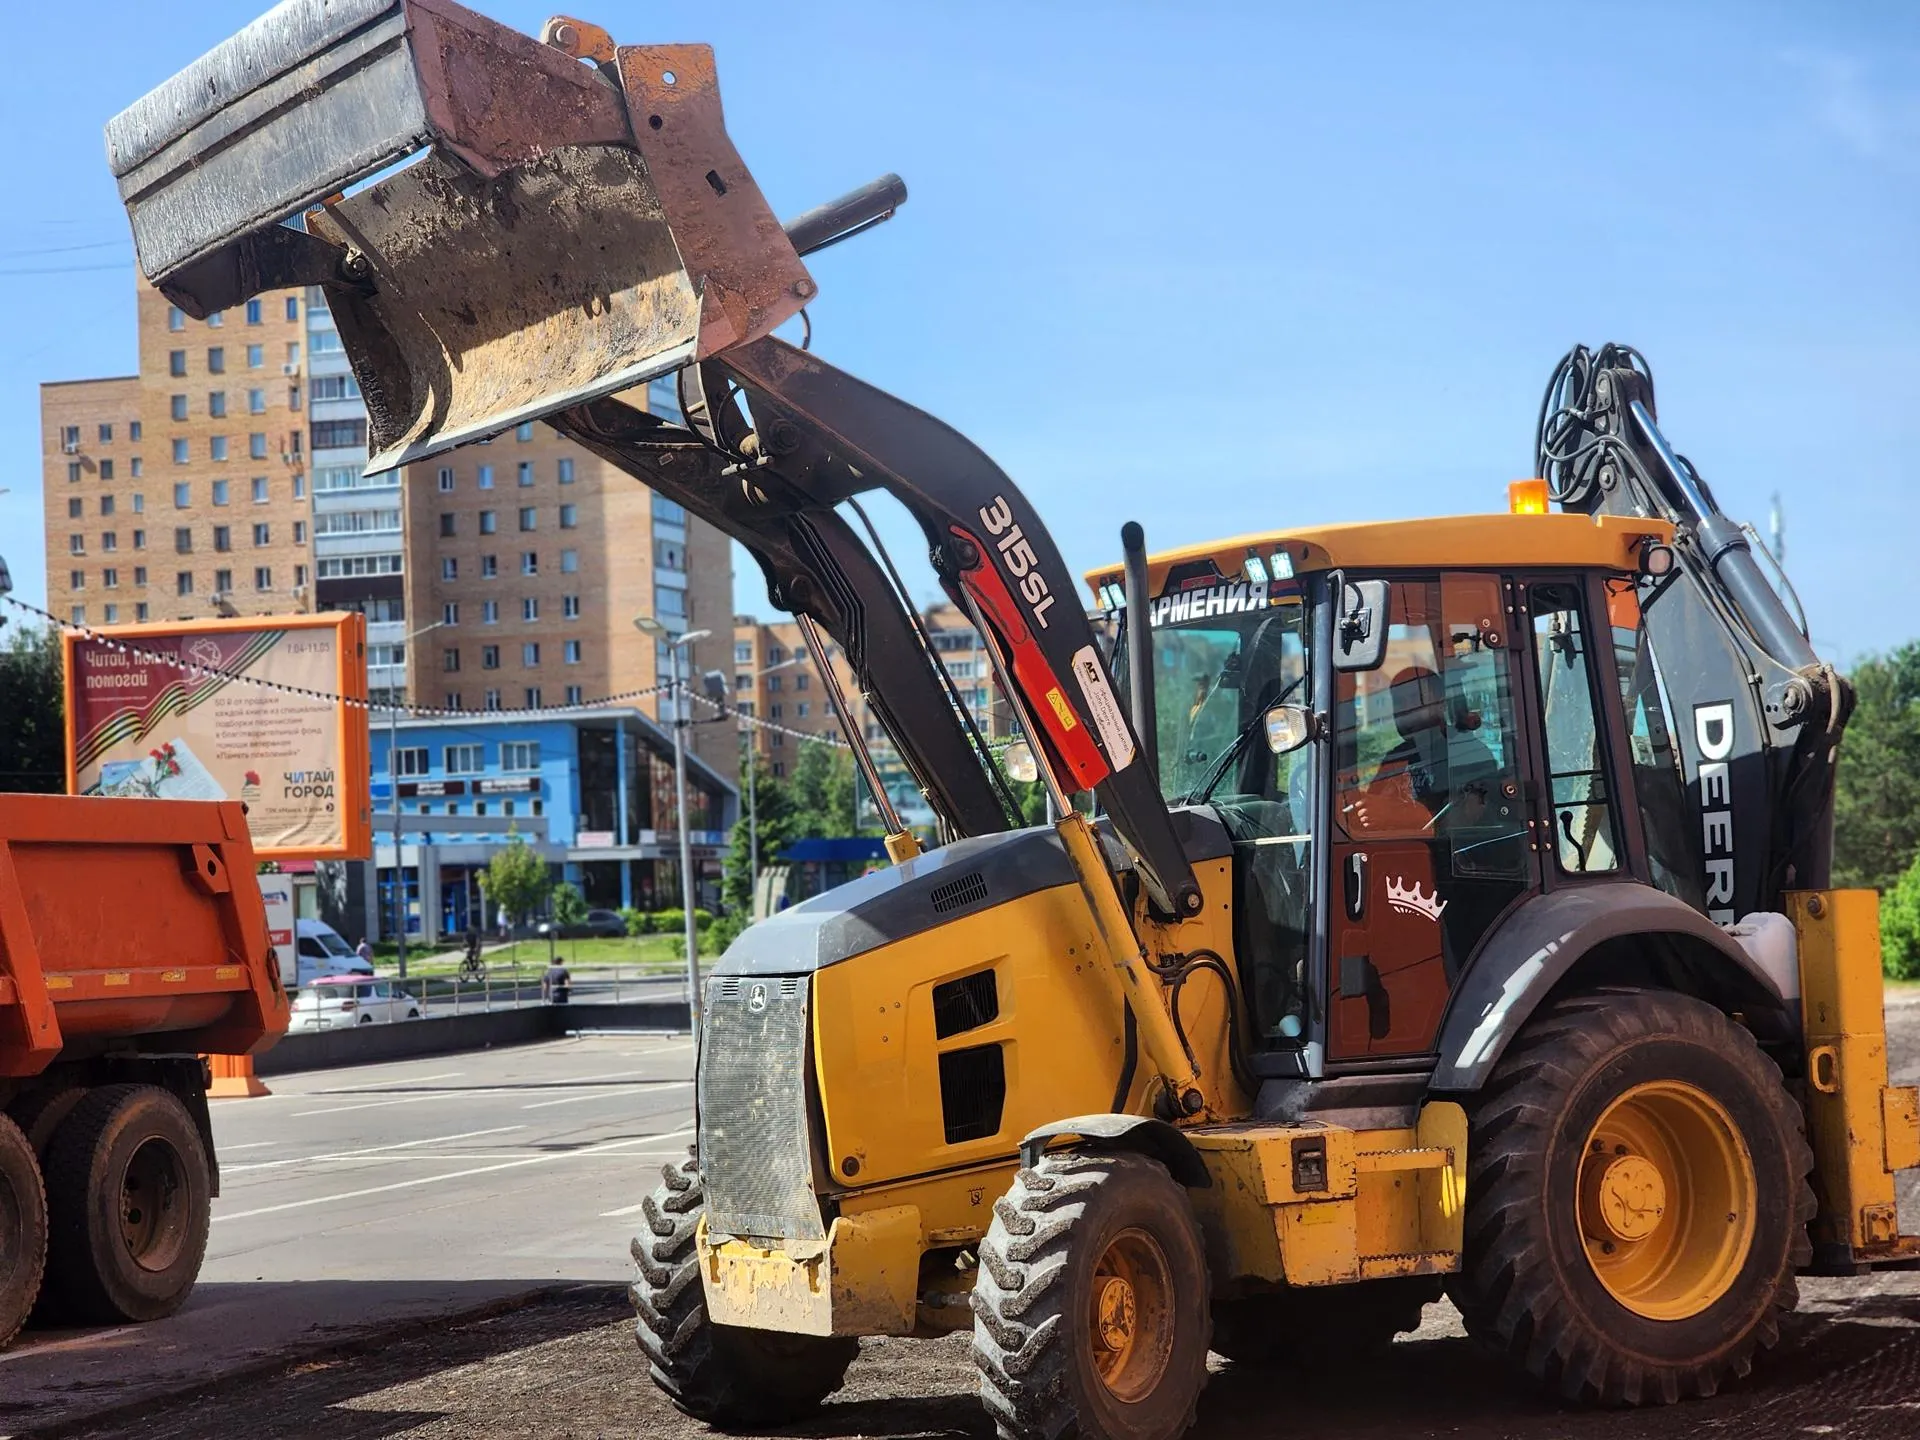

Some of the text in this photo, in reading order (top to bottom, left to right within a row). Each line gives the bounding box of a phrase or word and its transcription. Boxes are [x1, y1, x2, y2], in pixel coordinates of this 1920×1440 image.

[980, 495, 1055, 629] 315SL
[1149, 582, 1268, 627] АРМЕНИЯ
[86, 669, 148, 688] помогай
[283, 767, 334, 784] ЧИТАЙ
[284, 785, 334, 799] ГОРОД
